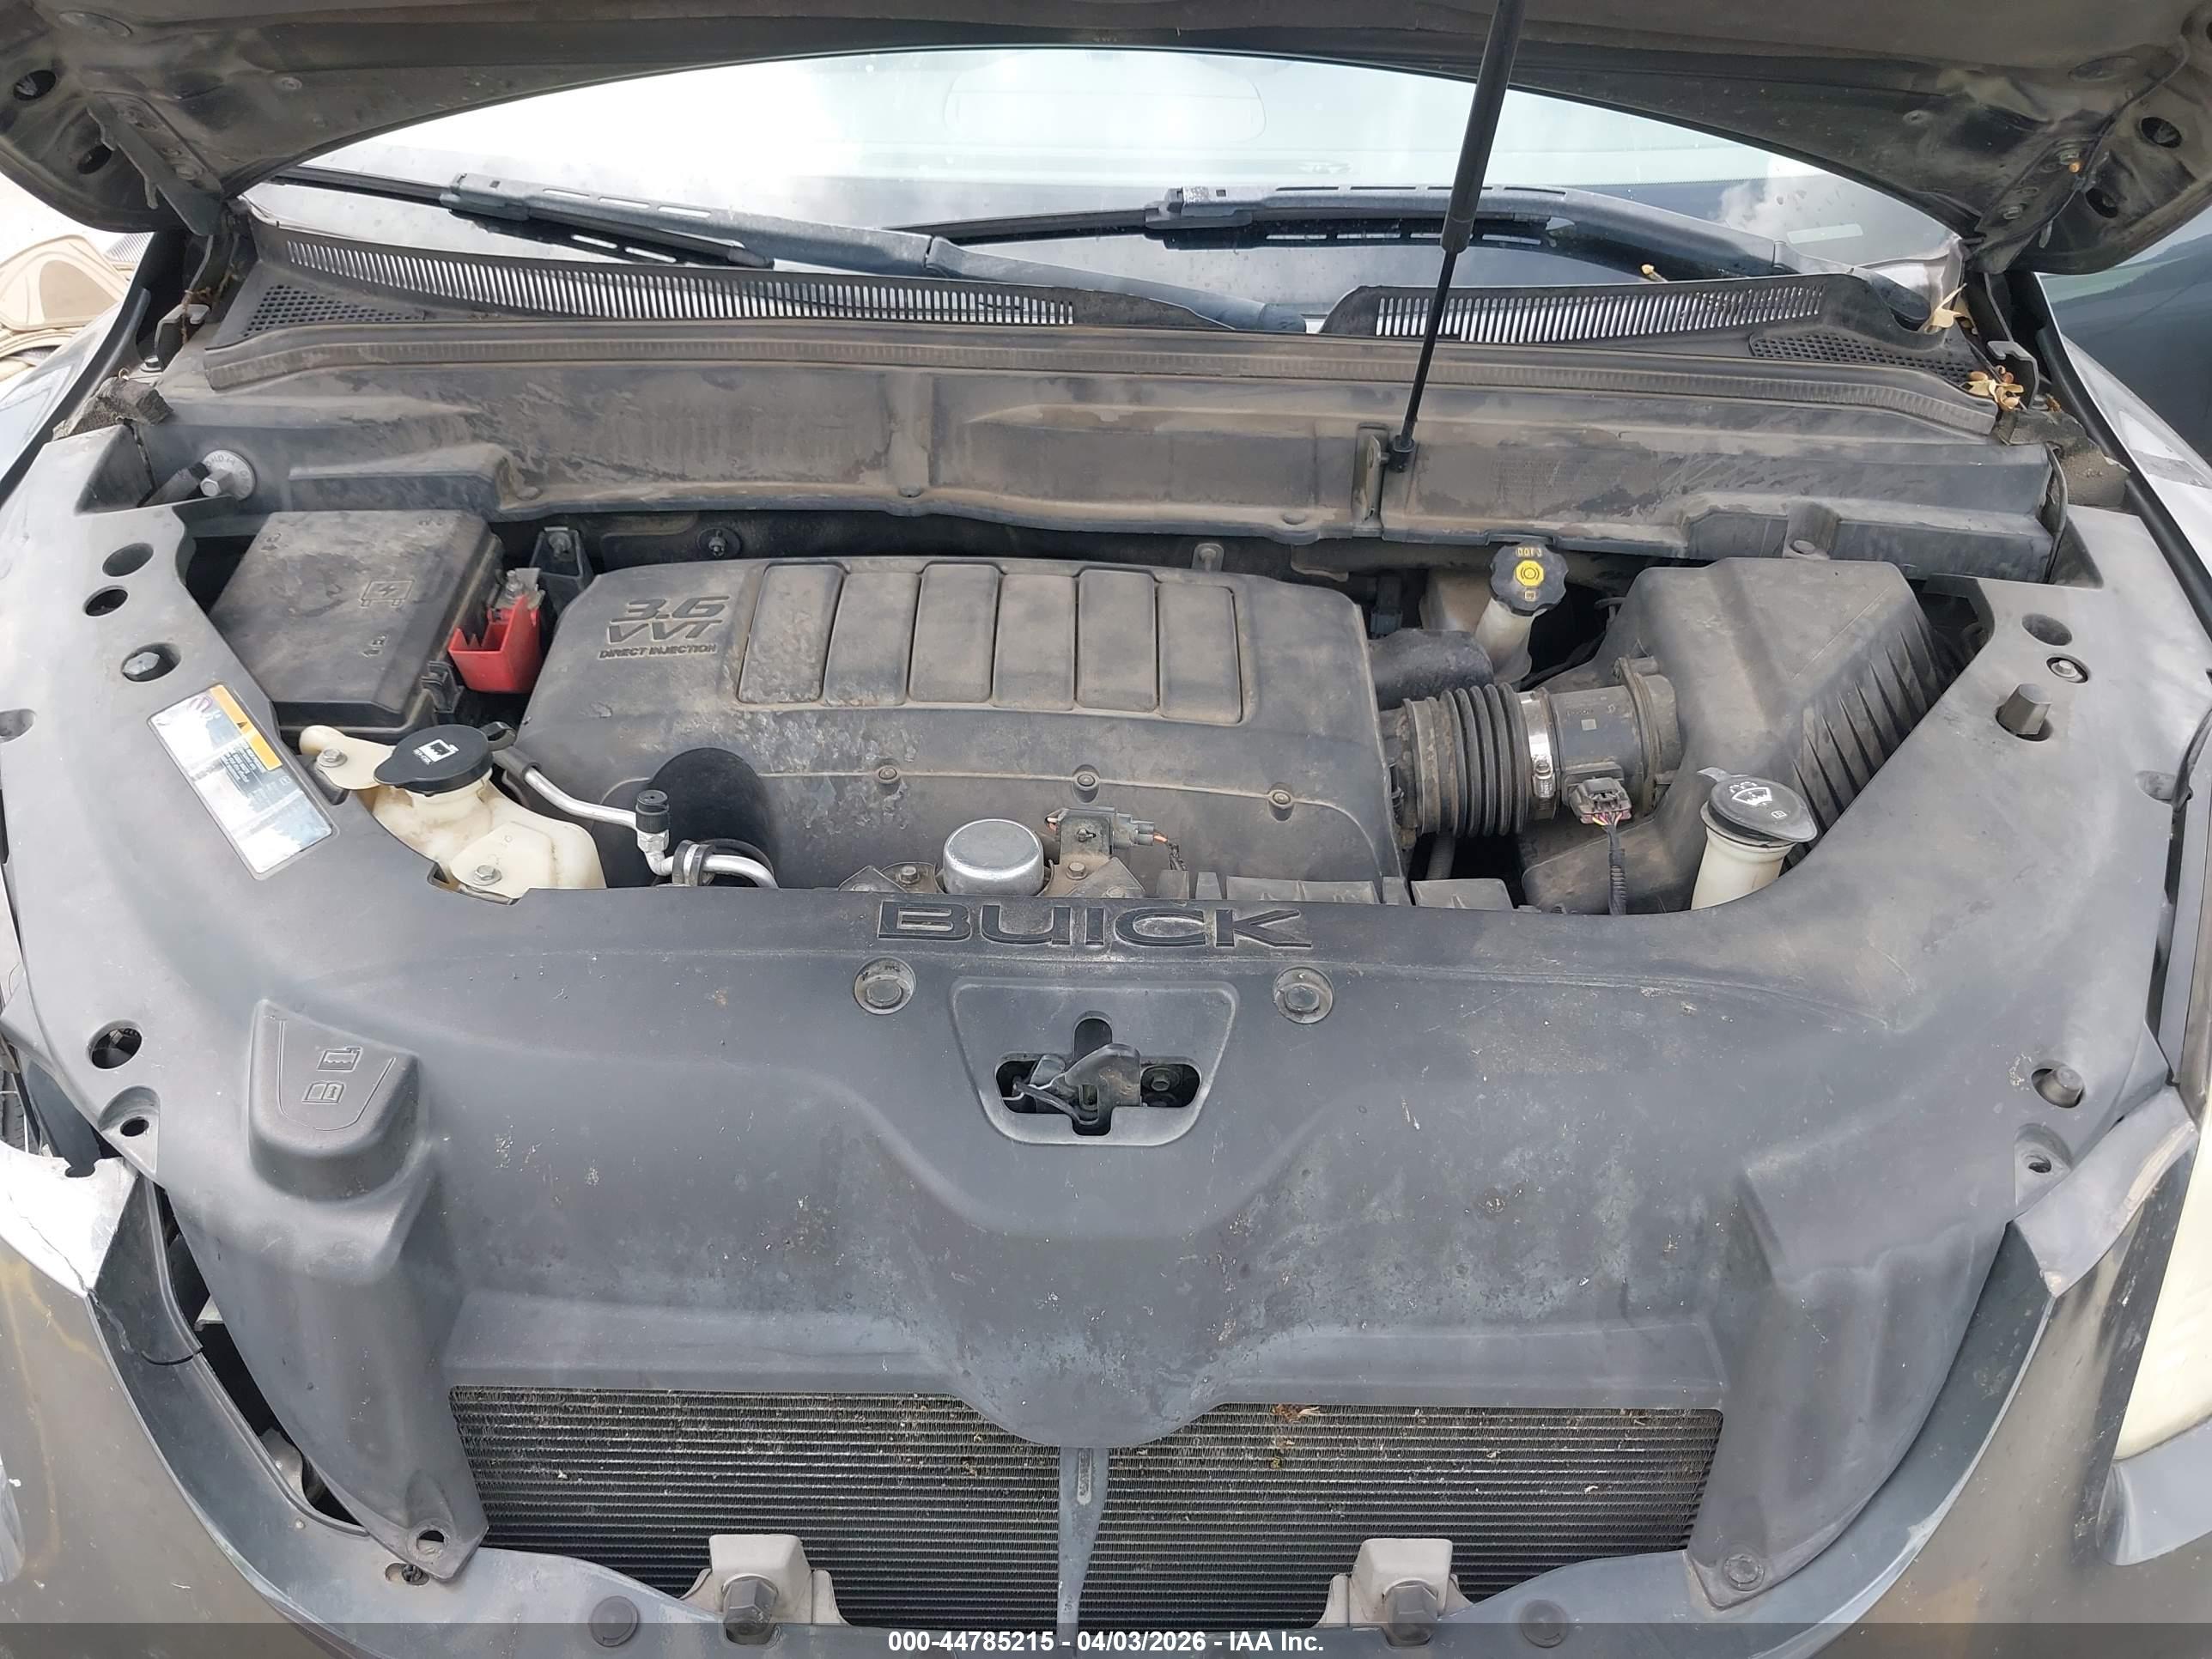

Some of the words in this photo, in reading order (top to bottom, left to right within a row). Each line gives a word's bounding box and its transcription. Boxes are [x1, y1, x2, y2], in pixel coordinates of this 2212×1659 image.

[1515, 547, 1534, 557] DOT
[611, 596, 730, 623] 3.6
[608, 619, 723, 643] VVT
[599, 646, 645, 660] DIRECT
[647, 644, 719, 657] INJECTION
[877, 900, 1313, 948] BUICK
